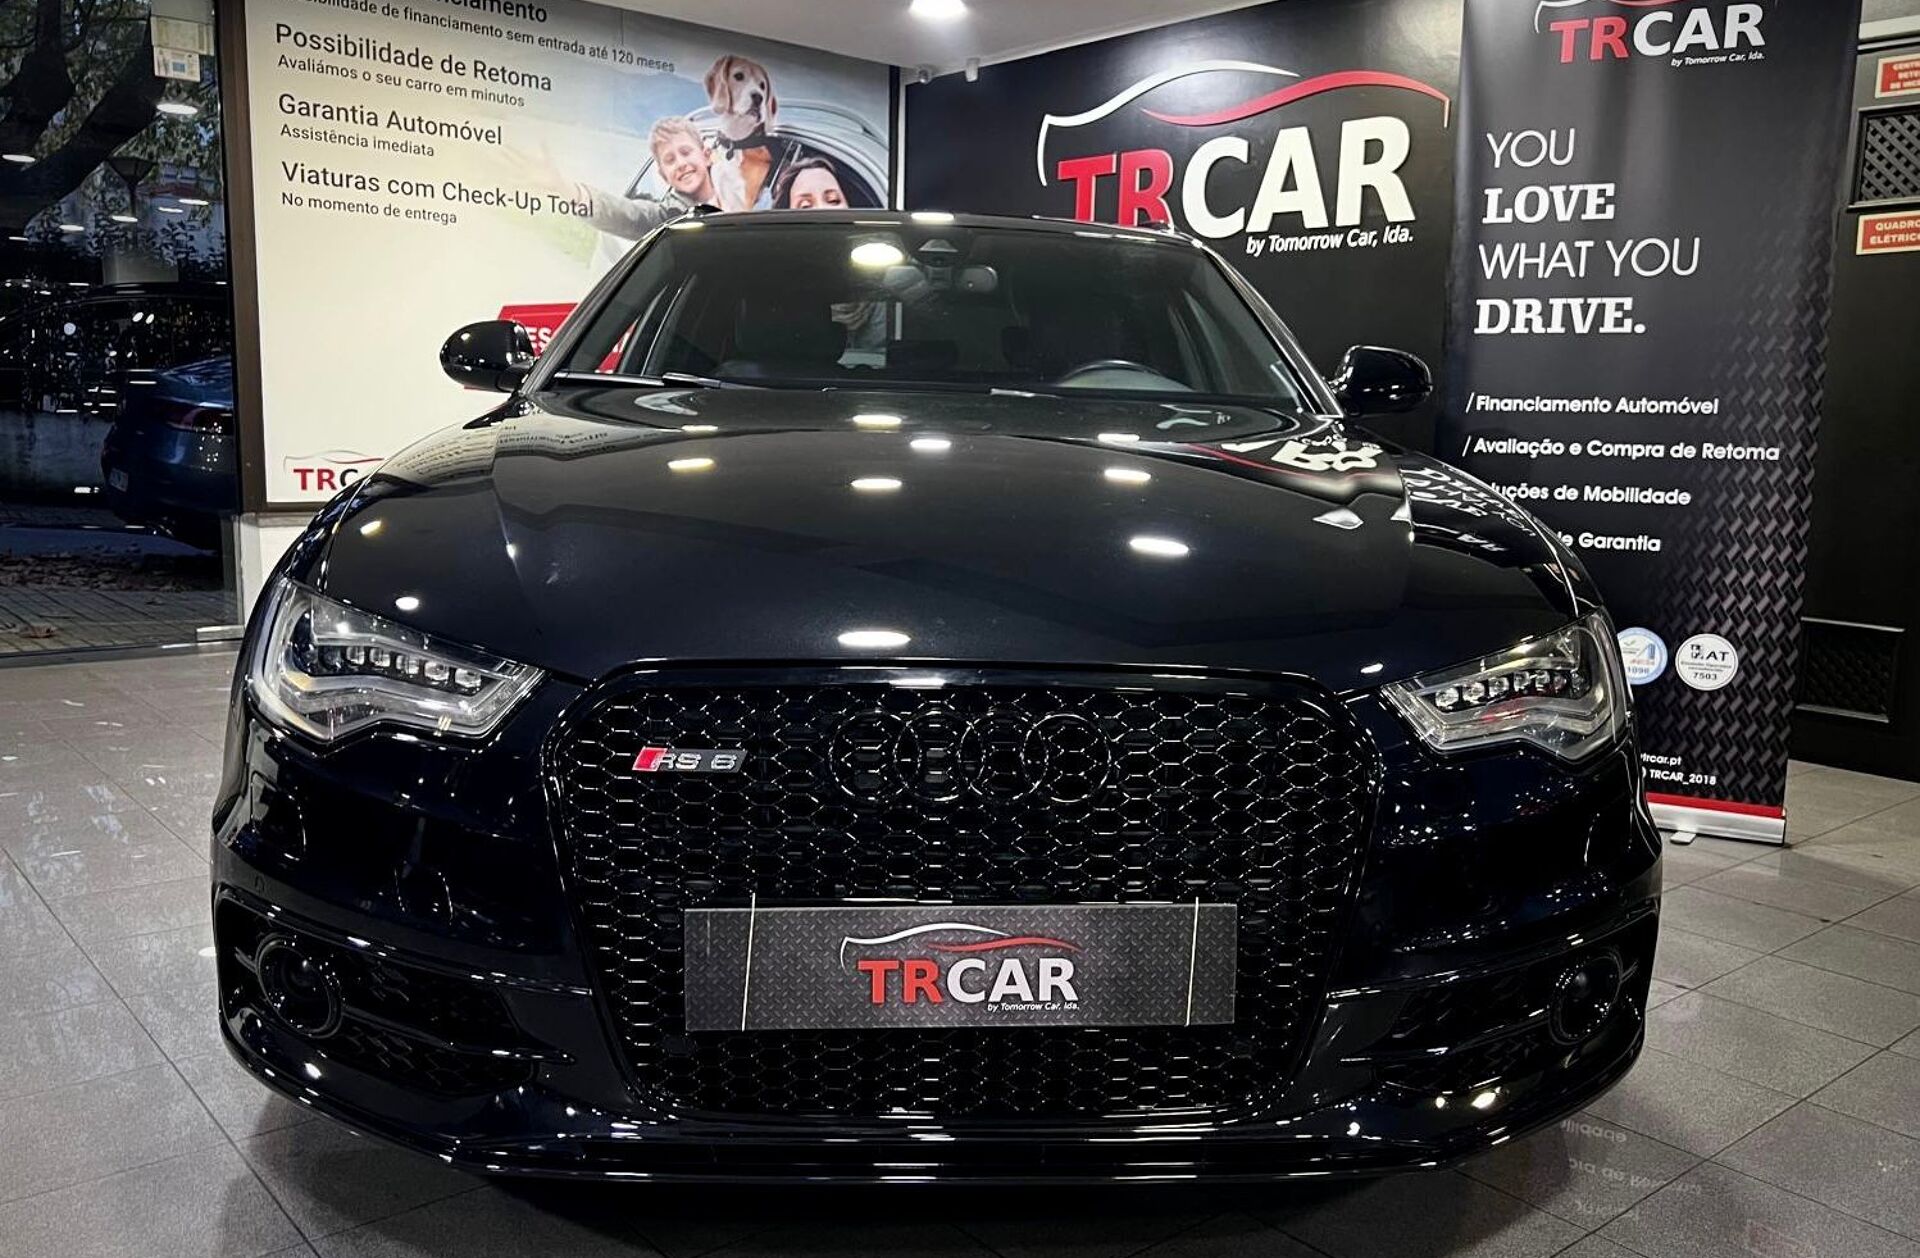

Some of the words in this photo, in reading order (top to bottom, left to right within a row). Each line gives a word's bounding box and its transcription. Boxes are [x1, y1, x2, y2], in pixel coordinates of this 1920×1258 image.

[381, 3, 400, 18] de
[403, 6, 503, 39] financiamento
[506, 29, 534, 45] sem
[538, 37, 586, 56] entrada
[589, 46, 608, 60] até
[612, 49, 634, 65] 120
[636, 56, 676, 73] meses
[1549, 3, 1766, 64] TRCAR
[275, 23, 433, 71] Possibilidade
[440, 54, 466, 76] de
[473, 60, 552, 92] Retoma
[1670, 58, 1683, 67] by
[1684, 55, 1728, 66] Tomorrow
[277, 54, 358, 80] Avaliámos
[362, 70, 371, 81] o
[375, 73, 401, 87] seu
[405, 78, 442, 94] carro
[446, 84, 467, 98] em
[471, 88, 525, 107] minutos
[278, 93, 378, 127] Garantia
[386, 110, 502, 145] Automóvel
[280, 123, 369, 148] Assistência
[373, 136, 435, 157] imediata
[1486, 127, 1576, 168] YOU
[281, 161, 380, 192] Viaturas
[387, 178, 435, 198] com
[442, 182, 542, 216] Check-Up
[547, 195, 594, 218] Total
[1057, 115, 1417, 239] TRCAR
[282, 192, 304, 207] No
[308, 197, 379, 215] momento
[383, 203, 401, 217] de
[405, 208, 457, 225] entrega
[1481, 182, 1616, 225] LOVE
[1245, 235, 1265, 257] by
[1268, 233, 1344, 253] Tomorrow
[1346, 228, 1378, 248] Car,
[1478, 240, 1595, 280] WHAT
[1605, 236, 1700, 277] YOU
[1473, 296, 1647, 335] DRIVE.
[1615, 396, 1719, 415] Automóvel
[1569, 442, 1583, 456] e
[1586, 439, 1665, 461] Compra
[1669, 442, 1696, 459] de
[1702, 442, 1780, 461] Retoma
[1553, 484, 1579, 501] de
[1583, 484, 1692, 506] Mobilidade
[1578, 532, 1661, 552] Garantia
[650, 752, 702, 770] RS
[710, 754, 738, 770] 6
[1640, 752, 1682, 766] trcar.pt
[1649, 768, 1717, 786] TRCAR_2018
[857, 957, 1079, 1005] TRCAR
[987, 1003, 999, 1013] by
[1001, 1002, 1043, 1011] Tomorrow
